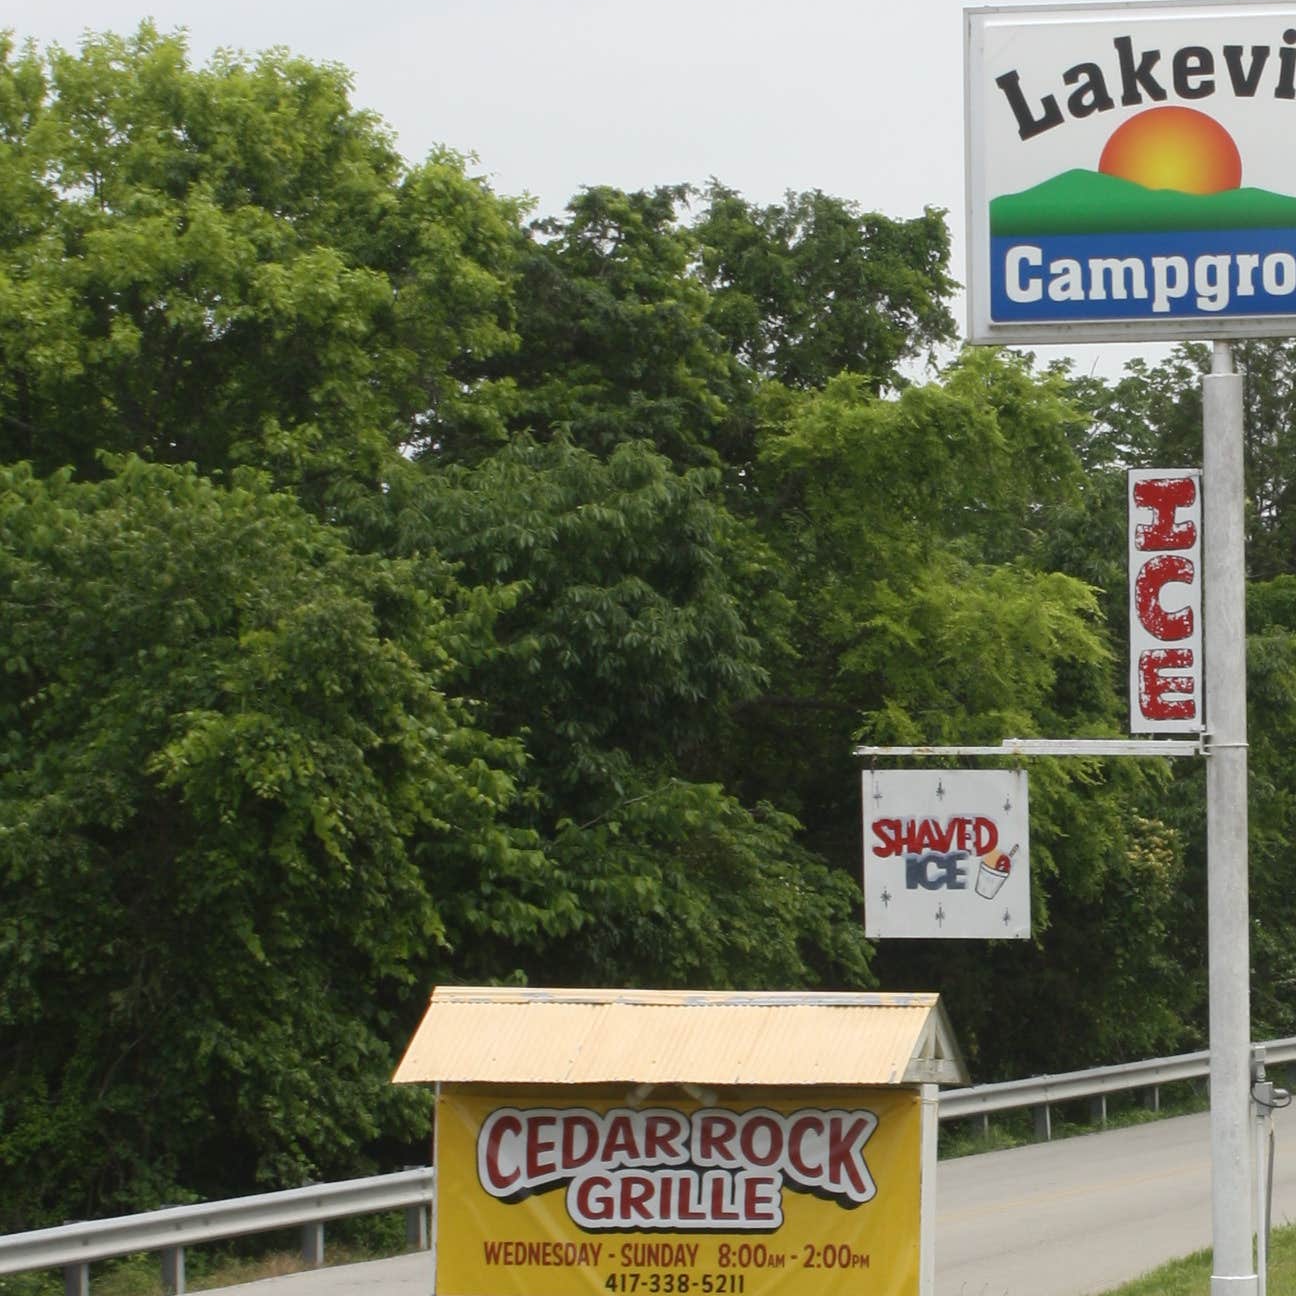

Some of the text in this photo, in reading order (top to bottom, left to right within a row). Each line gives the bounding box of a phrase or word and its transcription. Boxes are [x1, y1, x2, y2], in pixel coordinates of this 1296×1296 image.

[1133, 477, 1197, 720] ICE
[871, 816, 999, 858] SHAVED
[906, 854, 969, 890] ICE
[486, 1115, 869, 1194] CEDAR ROCK
[576, 1175, 775, 1221] GRILLE
[484, 1241, 602, 1267] WEDNESDAY
[621, 1243, 699, 1267] SUNDAY
[605, 1273, 744, 1294] 417-338-5211
